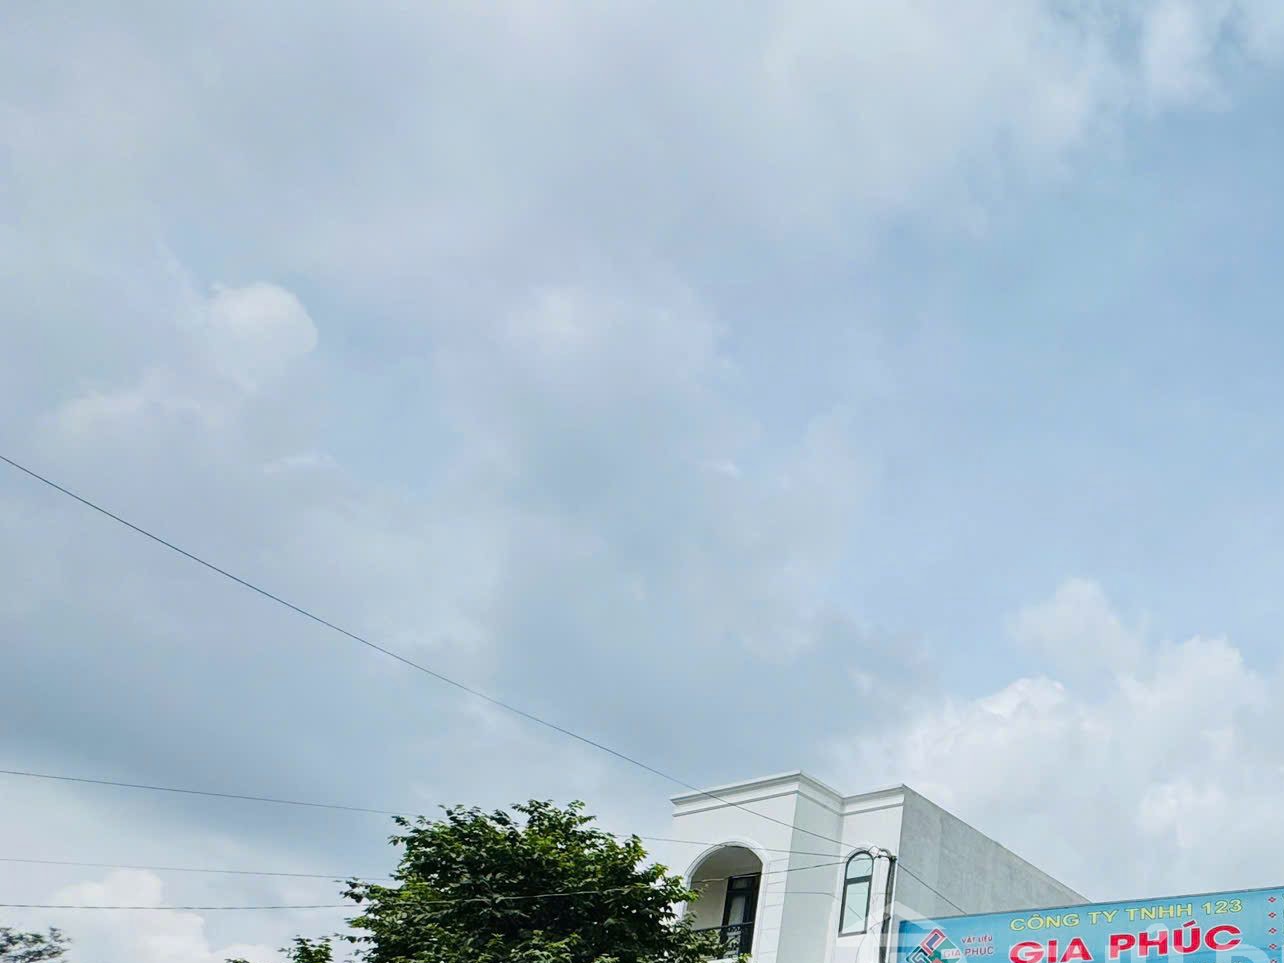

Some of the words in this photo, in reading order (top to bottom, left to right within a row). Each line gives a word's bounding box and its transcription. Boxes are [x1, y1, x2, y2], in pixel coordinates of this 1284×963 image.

[1009, 913, 1081, 931] CÔNG
[1088, 909, 1120, 926] TY
[1125, 903, 1194, 922] TNHH
[1201, 898, 1244, 915] 123
[1107, 919, 1243, 960] PHÚC
